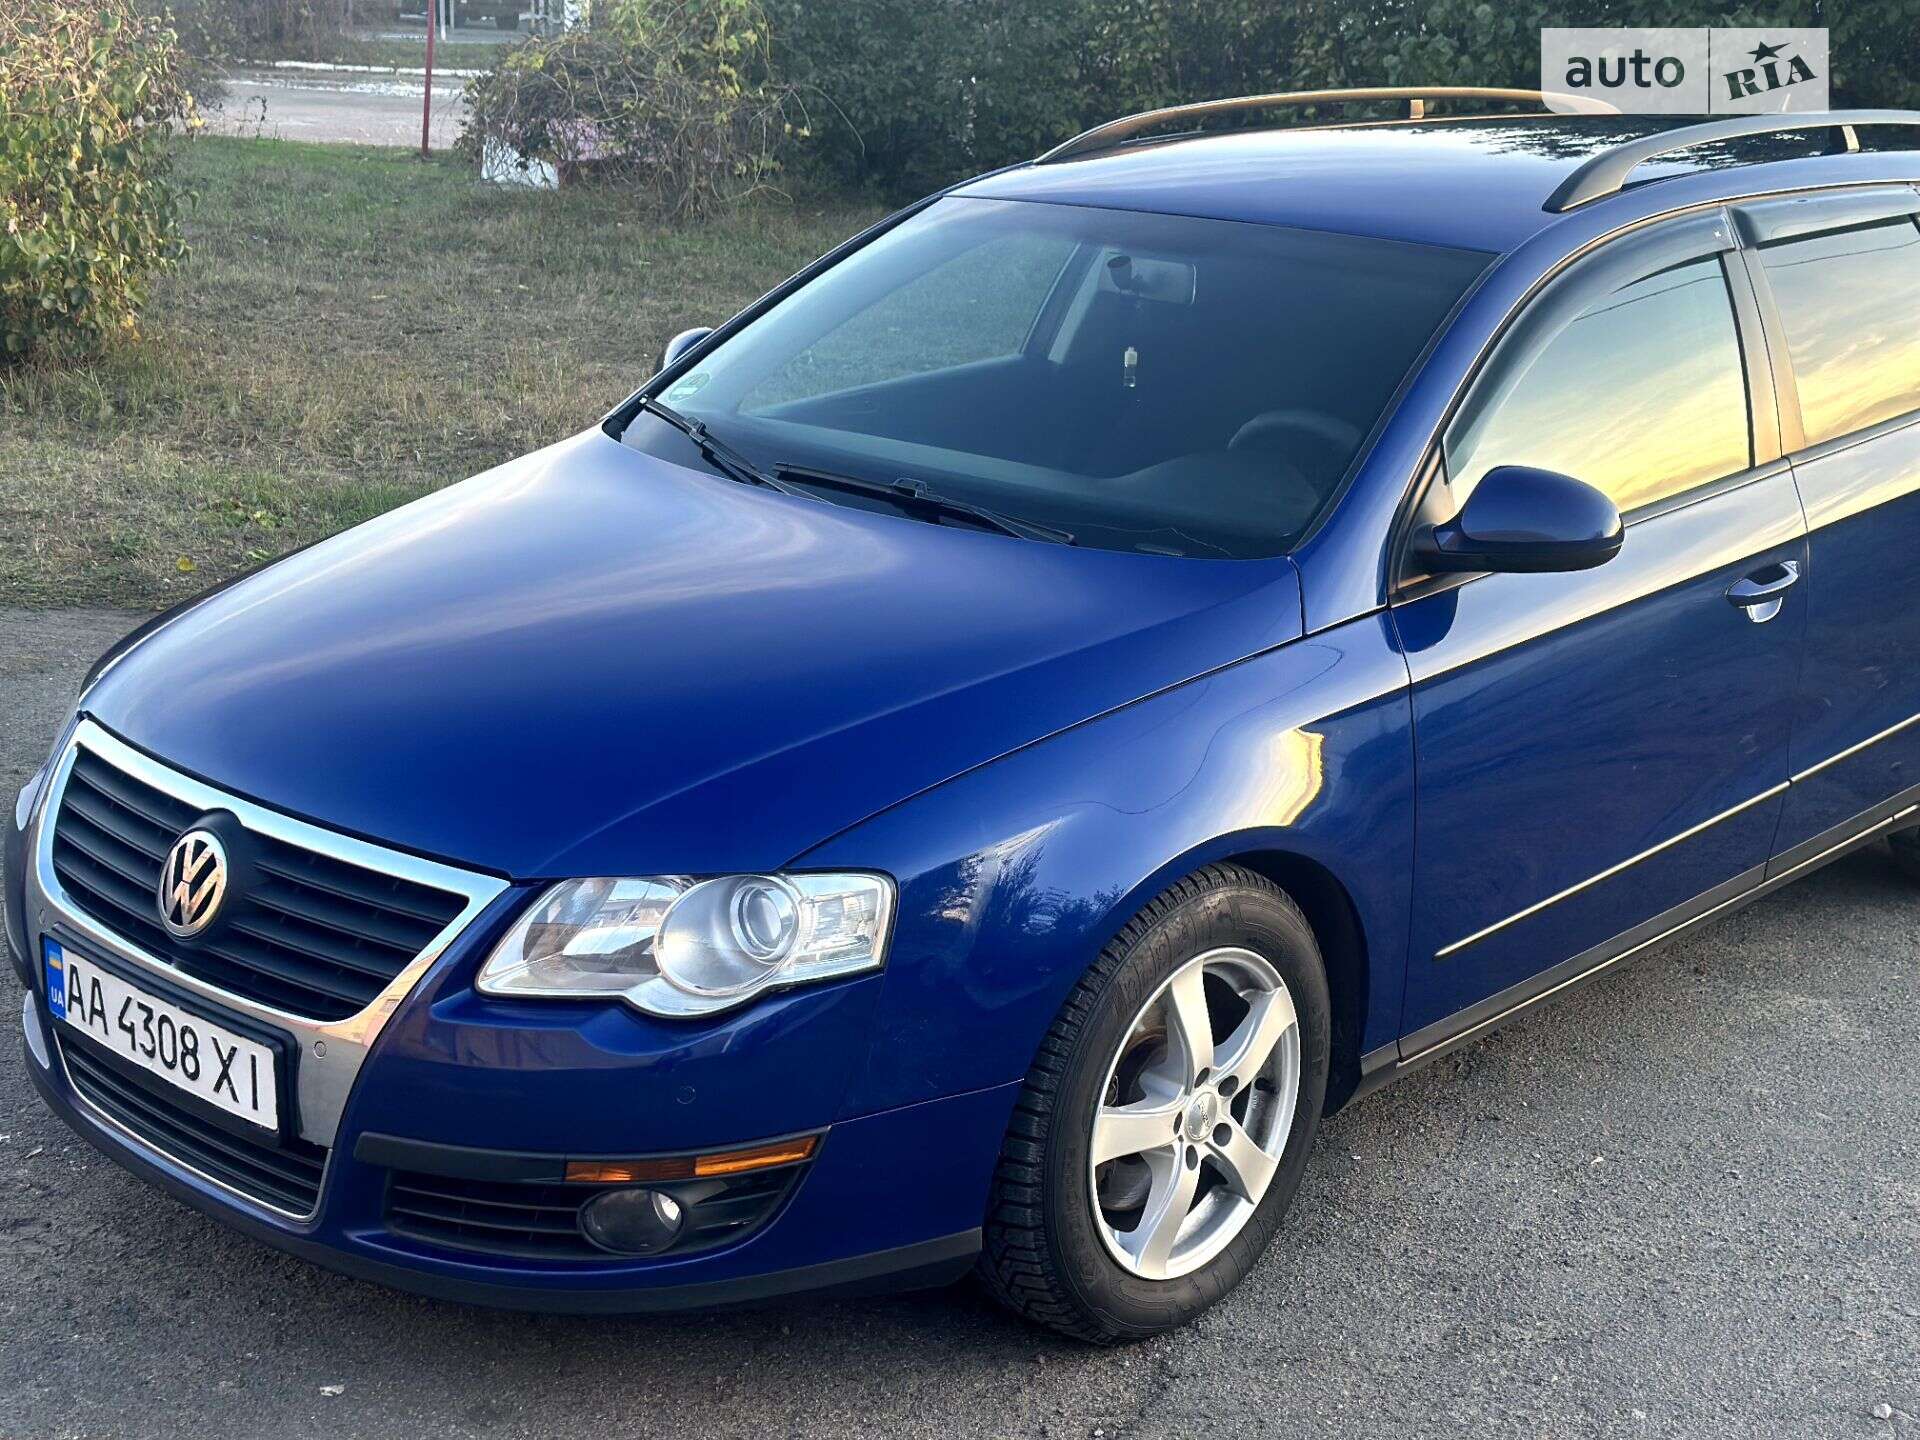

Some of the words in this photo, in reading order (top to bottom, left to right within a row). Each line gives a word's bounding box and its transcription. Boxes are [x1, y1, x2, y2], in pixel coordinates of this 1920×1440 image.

[50, 985, 64, 1008] UA
[67, 963, 109, 1036] AA
[118, 995, 201, 1082] 4308
[211, 1036, 259, 1111] XI
